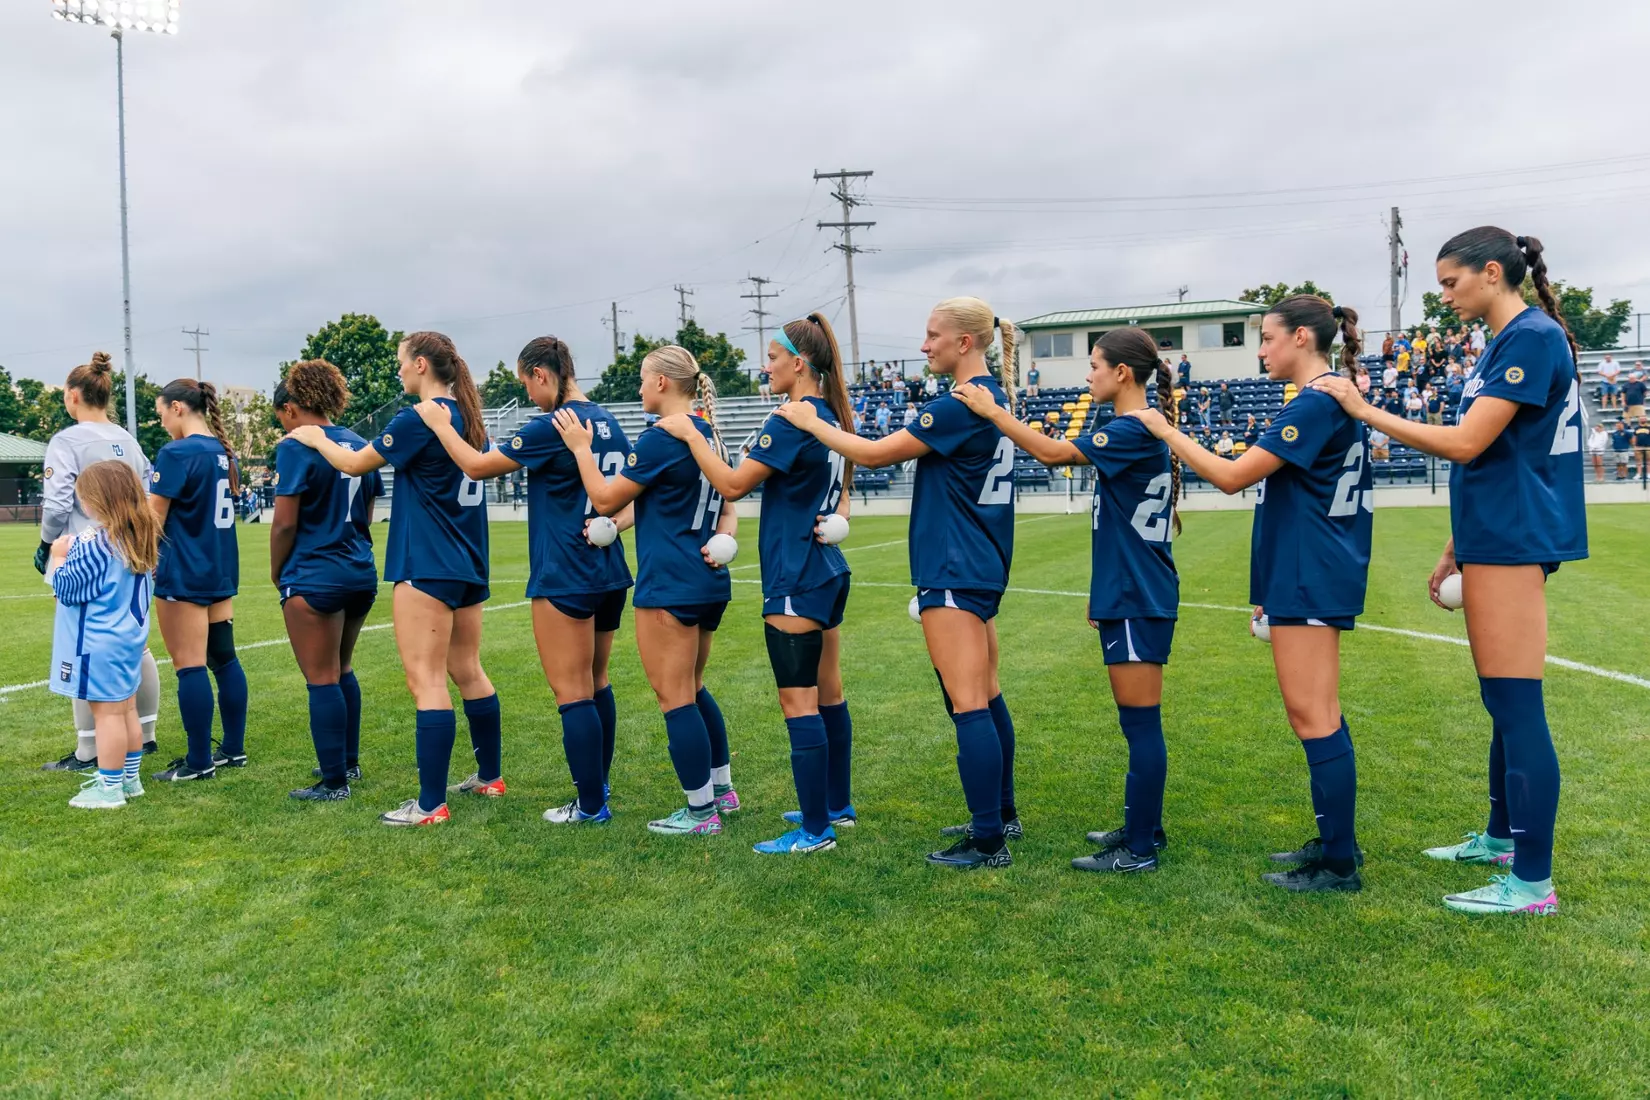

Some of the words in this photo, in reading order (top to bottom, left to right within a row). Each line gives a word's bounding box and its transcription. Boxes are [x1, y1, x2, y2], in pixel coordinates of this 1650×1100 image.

[214, 478, 235, 529] 6
[1131, 472, 1173, 543] 2
[1327, 440, 1374, 517] 2
